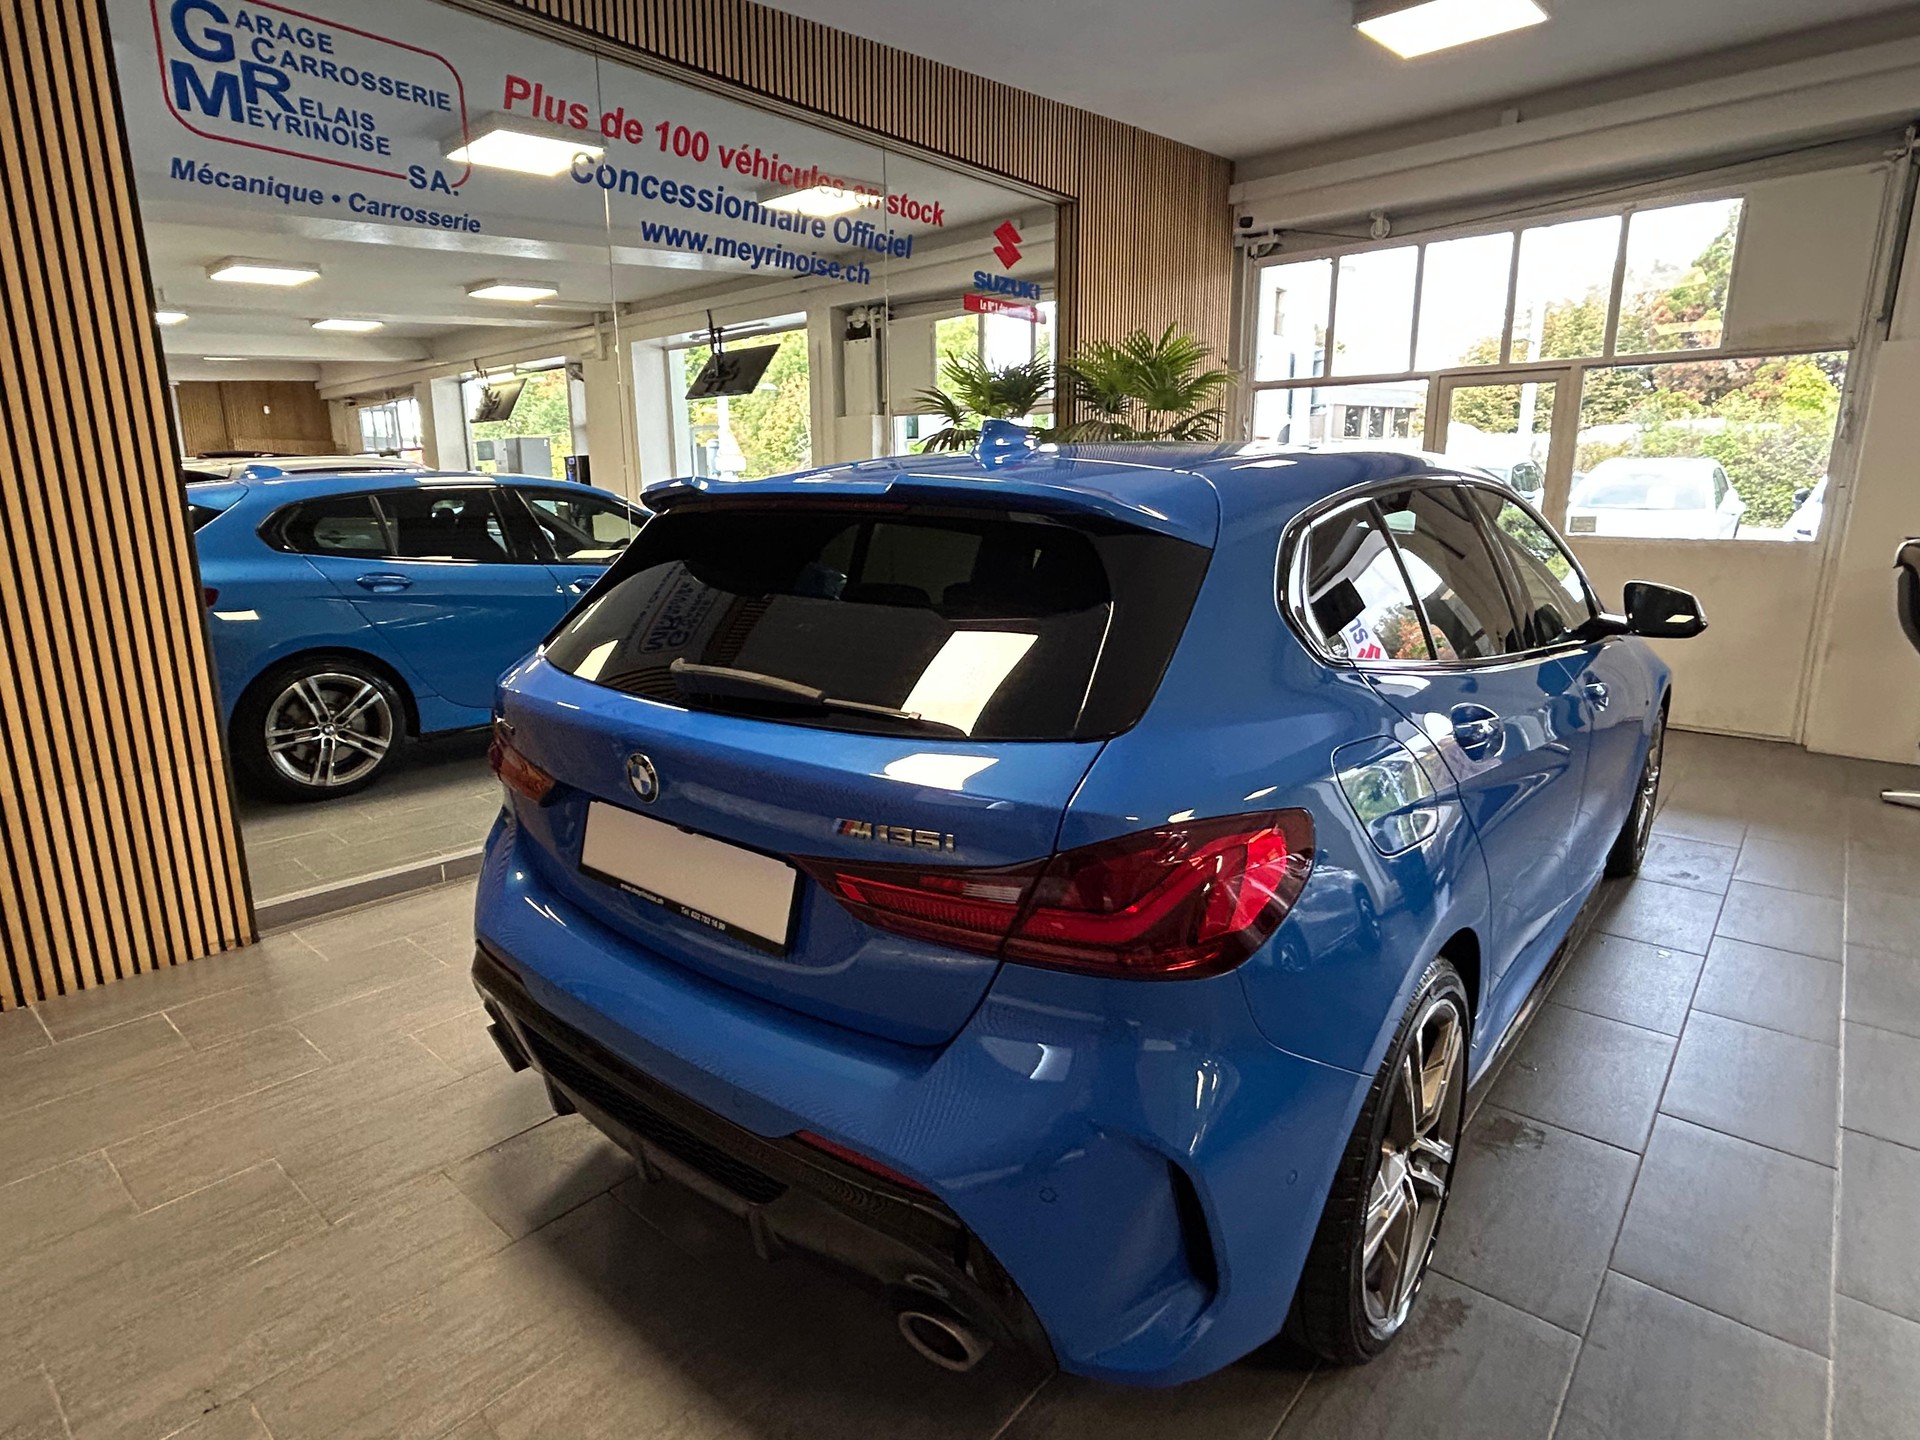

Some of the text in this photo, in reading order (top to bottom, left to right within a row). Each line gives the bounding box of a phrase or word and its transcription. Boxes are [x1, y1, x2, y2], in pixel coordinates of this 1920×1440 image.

[252, 37, 452, 111] CARROSSERIE
[503, 75, 945, 227] Plus de 100 véhicules en stock
[170, 157, 482, 233] Mécanique Carrosserie
[571, 152, 913, 259] Concessionnaire Officiel
[641, 220, 871, 286] www.meyrinoise.ch
[973, 270, 1040, 301] SUZUKI
